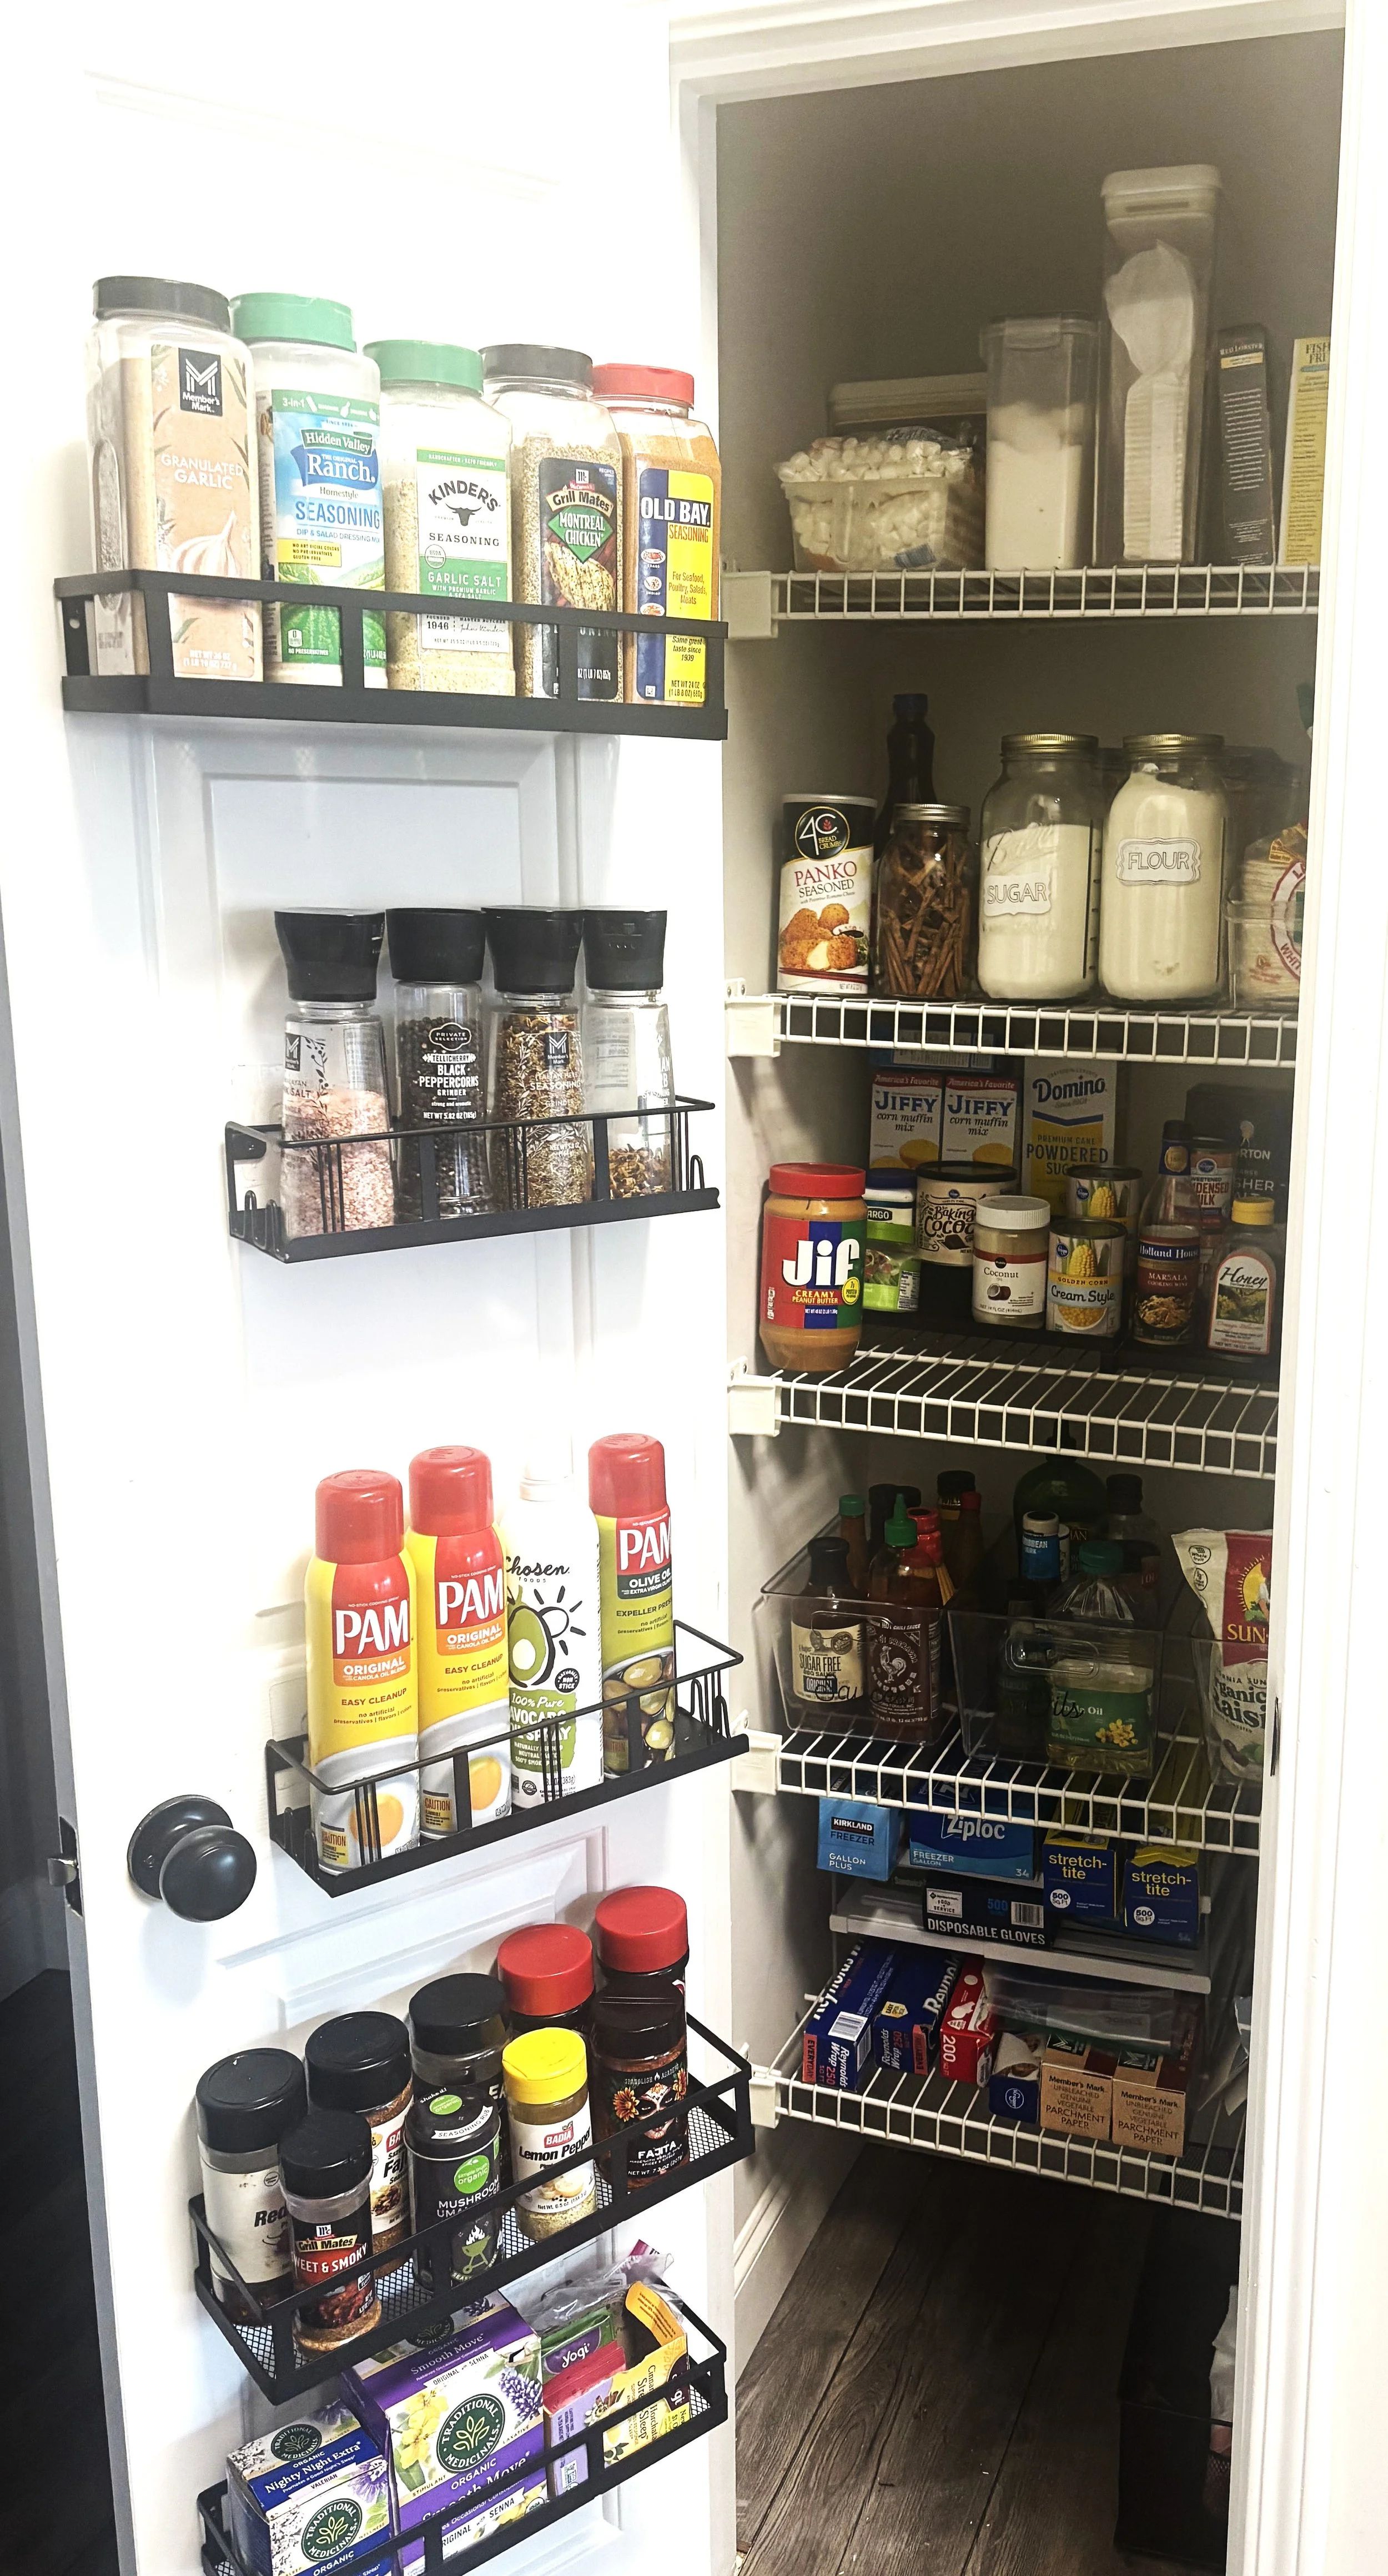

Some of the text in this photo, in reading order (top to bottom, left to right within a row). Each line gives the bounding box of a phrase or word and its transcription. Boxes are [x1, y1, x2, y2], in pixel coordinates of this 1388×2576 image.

[305, 432, 370, 454] Hidden Valley
[161, 454, 244, 476] GRANULATED
[174, 469, 233, 490] GARLIC
[320, 487, 359, 499] Homestyle
[429, 481, 498, 512] KINDER'S
[553, 491, 610, 511] Grill Mates
[295, 501, 380, 530] SEASONING
[641, 497, 675, 521] OLD
[559, 512, 605, 531] MONTREAL
[340, 533, 371, 542] DRESSING
[429, 533, 499, 546] SEASONING
[565, 530, 601, 547] CHICKEN
[669, 525, 708, 542] SEASONING
[428, 572, 501, 587] GARLIC SALT
[449, 586, 474, 594] PREMIUM
[681, 595, 696, 604] Meats
[1128, 851, 1189, 870] FLOUR
[795, 861, 857, 887] PANKO
[799, 879, 854, 898] SEASONED
[987, 883, 1047, 904] SUGAR
[437, 1065, 466, 1075] BLACK
[419, 1076, 479, 1088] PEPPERCORNS
[530, 1080, 581, 1091] SEASONING
[875, 1075, 938, 1086] America's Favorite
[985, 1080, 1015, 1089] Favorite
[1033, 1075, 1105, 1103] Domino
[877, 1112, 933, 1123] corn muffin
[949, 1116, 1008, 1127] corn muffin
[895, 1123, 915, 1132] mix
[968, 1127, 989, 1136] mix
[1038, 1135, 1073, 1143] PREMIUM
[1027, 1144, 1108, 1163] POWDERED
[1139, 1243, 1171, 1258] Holland
[782, 1239, 859, 1286] Jif
[984, 1268, 1019, 1278] Coconut
[1058, 1277, 1086, 1285] GOLDEN
[1148, 1272, 1188, 1281] MARSALA
[1220, 1267, 1267, 1288] Honey
[796, 1289, 834, 1298] CREAMY
[1051, 1286, 1114, 1305] Cream Style
[629, 1575, 660, 1589] OLIVE
[439, 1567, 503, 1625] PAM
[616, 1607, 656, 1616] EXPELLER
[336, 1599, 409, 1655] PAM
[447, 1623, 501, 1644] ORIGINAL
[343, 1656, 404, 1675] ORIGINAL
[445, 1654, 503, 1674] EASY CLEANUP
[799, 1654, 841, 1671] SUGAR FREE
[369, 1688, 406, 1704] CLEANUP
[511, 1693, 564, 1707] 100% Pure
[370, 1706, 394, 1717] artificial
[379, 1713, 396, 1722] flavors
[1088, 1706, 1103, 1715] Oil
[425, 1798, 450, 1811] CAUTION
[834, 1818, 872, 1831] KIRKLAND
[947, 1815, 1005, 1841] Ziploc
[323, 1834, 346, 1846] CAUTION
[831, 1832, 874, 1845] FREEZER
[829, 1853, 866, 1864] GALLON
[913, 1851, 954, 1862] FREEZER
[1049, 1854, 1107, 1868] stretch-
[829, 1861, 852, 1870] PLUS
[1063, 1867, 1085, 1879] tite
[1131, 1872, 1191, 1885] stretch-
[1146, 1884, 1170, 1896] tite
[928, 1918, 1045, 1945] DISPOSABLE GLOVES
[882, 2028, 890, 2065] Reynolds
[943, 2035, 956, 2063] 200
[806, 2040, 814, 2078] EVERYDAY
[827, 2041, 841, 2086] Wrap 250
[891, 2047, 902, 2069] Wrap
[839, 2046, 849, 2088] Reynolds
[1049, 2075, 1105, 2092] Member's Mark
[1054, 2085, 1099, 2098] UNBLEACHED
[1060, 2094, 1092, 2104] GENUINE
[1122, 2091, 1178, 2108] Member's Mark
[1046, 2105, 1105, 2123] PARCHMENT
[439, 2120, 481, 2137] SEASONING
[1062, 2118, 1089, 2129] PAPER
[1118, 2121, 1179, 2140] PARCHMENT
[546, 2130, 571, 2145] BADIA
[1134, 2133, 1162, 2145] PAPER
[520, 2146, 558, 2160] Lemon
[638, 2141, 676, 2159] FAJITA
[459, 2167, 487, 2185] organic
[439, 2175, 499, 2209] MUSHROOM
[321, 2238, 353, 2249] Mates
[322, 2243, 368, 2272] & SMOKY
[411, 2336, 483, 2375] Smooth Move
[562, 2344, 590, 2368] yogi
[433, 2353, 489, 2385] ORIGINAL SENNA
[442, 2399, 499, 2444] TRADITIONAL
[445, 2428, 499, 2468] MEDICINALS
[293, 2451, 325, 2468] ORGANIC
[264, 2444, 361, 2493] Nighty Night Extra
[451, 2458, 496, 2490] ORGANIC
[311, 2474, 338, 2489] VALERIAN
[413, 2474, 446, 2497] STIMULANT
[490, 2498, 514, 2518] SENNA
[306, 2503, 357, 2540] TRADITIONAL
[309, 2525, 357, 2557] MEDICINALS
[313, 2551, 354, 2576] ORGANIC
